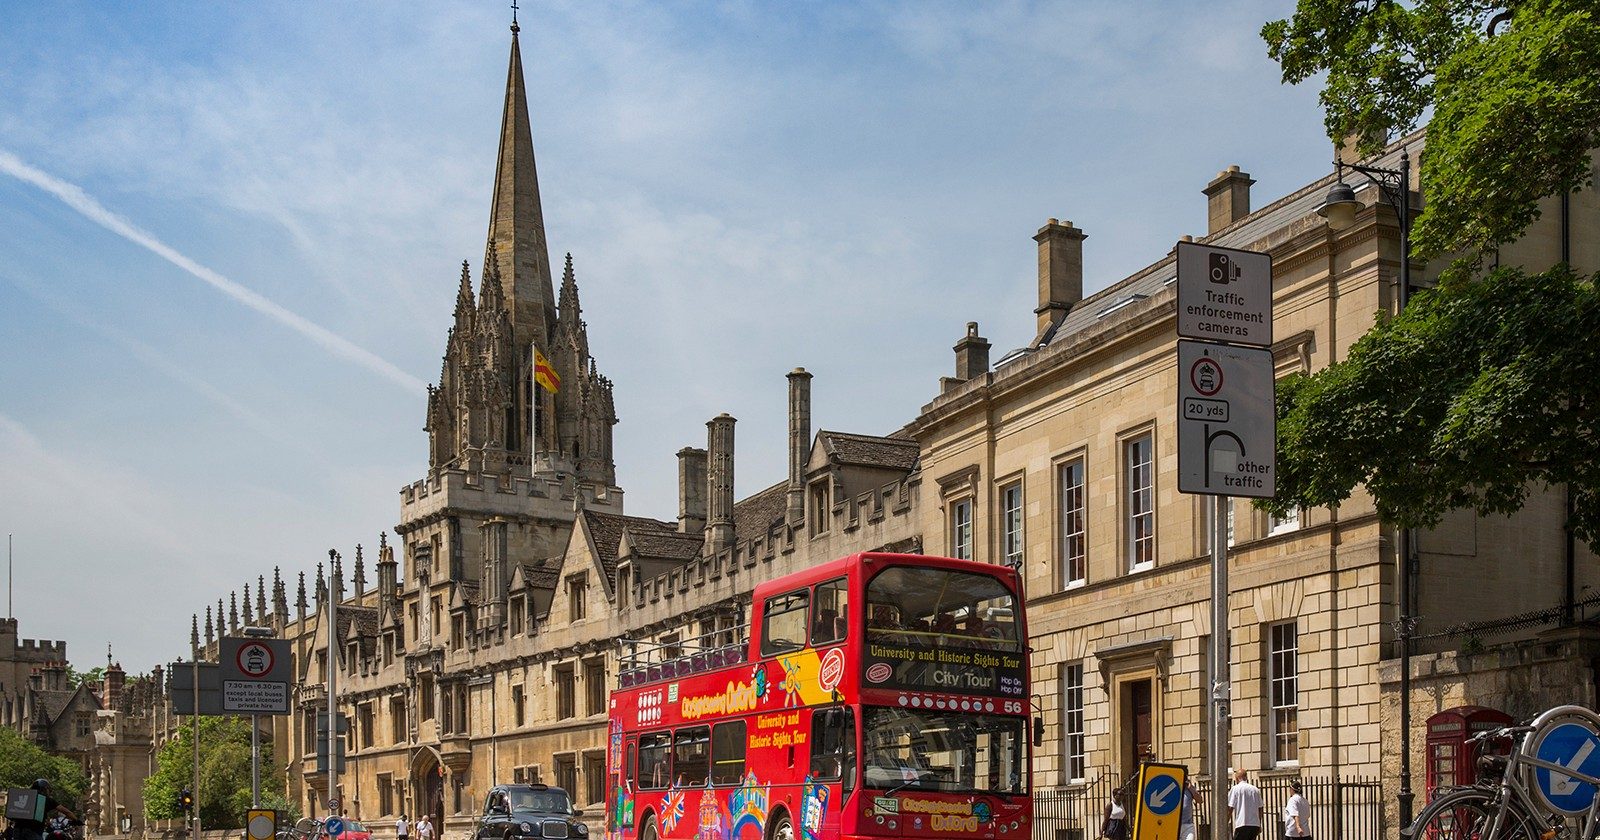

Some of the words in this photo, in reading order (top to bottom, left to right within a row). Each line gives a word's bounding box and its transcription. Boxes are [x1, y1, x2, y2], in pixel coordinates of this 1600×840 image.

[1205, 290, 1245, 306] Traffic
[1187, 304, 1264, 323] enforcement
[1198, 322, 1249, 336] cameras
[1189, 403, 1204, 414] 20
[1206, 406, 1224, 416] yds
[1237, 461, 1271, 474] other
[1224, 474, 1263, 488] traffic
[870, 645, 916, 662] University
[918, 649, 935, 661] and
[938, 649, 971, 664] Historic
[973, 653, 1000, 668] Sights
[1002, 655, 1020, 668] Tour
[933, 670, 960, 686] City
[964, 672, 992, 687] Tour
[1000, 676, 1013, 685] Hop
[1013, 677, 1022, 686] On
[1000, 685, 1012, 694] Hop
[1013, 687, 1023, 695] Off
[1004, 700, 1022, 713] 56
[787, 710, 800, 725] and
